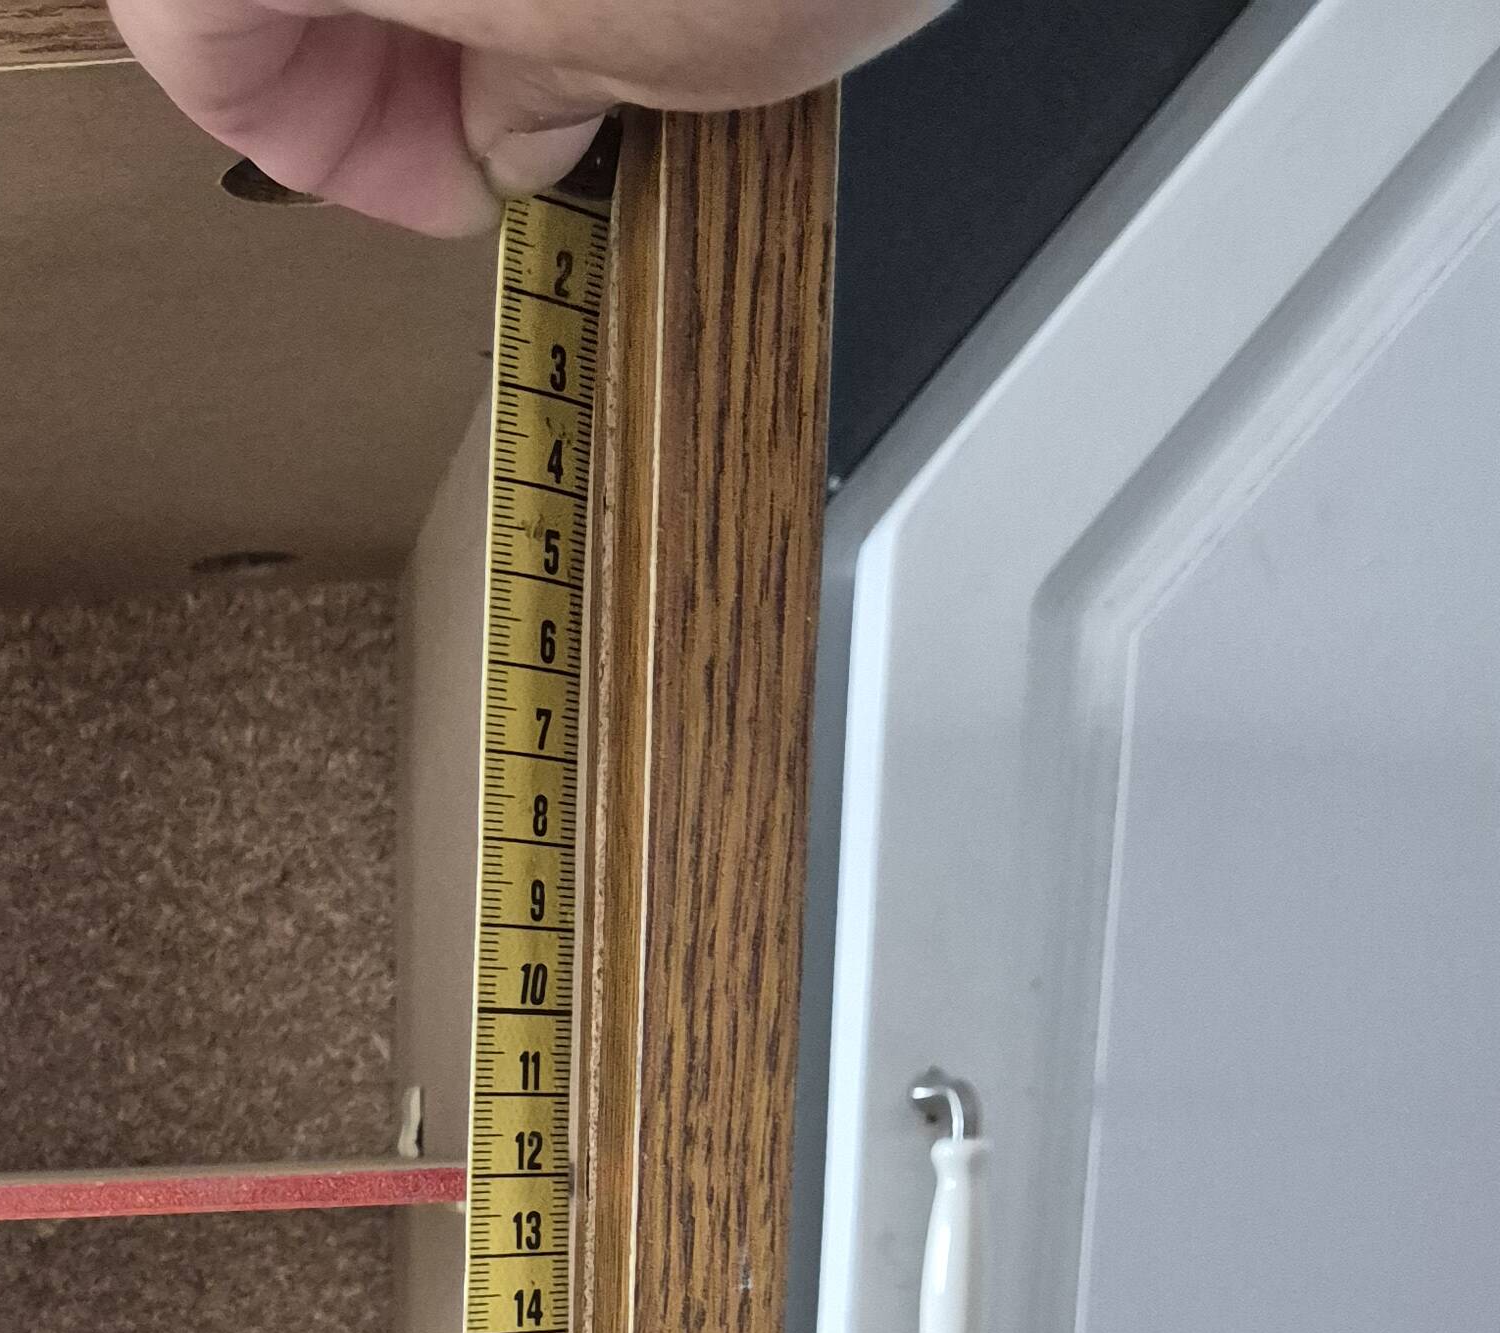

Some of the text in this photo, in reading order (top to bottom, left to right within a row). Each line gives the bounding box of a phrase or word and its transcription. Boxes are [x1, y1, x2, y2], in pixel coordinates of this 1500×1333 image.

[555, 251, 573, 297] 2
[550, 344, 567, 392] 3
[547, 439, 564, 484] 4
[544, 529, 560, 575] 5
[540, 619, 556, 664] 6
[536, 708, 552, 750] 7
[532, 794, 548, 837] 8
[530, 880, 546, 921] 9
[520, 963, 548, 1005] 10
[519, 1051, 541, 1091] 11
[515, 1131, 543, 1170] 12
[512, 1211, 542, 1250] 13
[514, 1289, 543, 1327] 14
